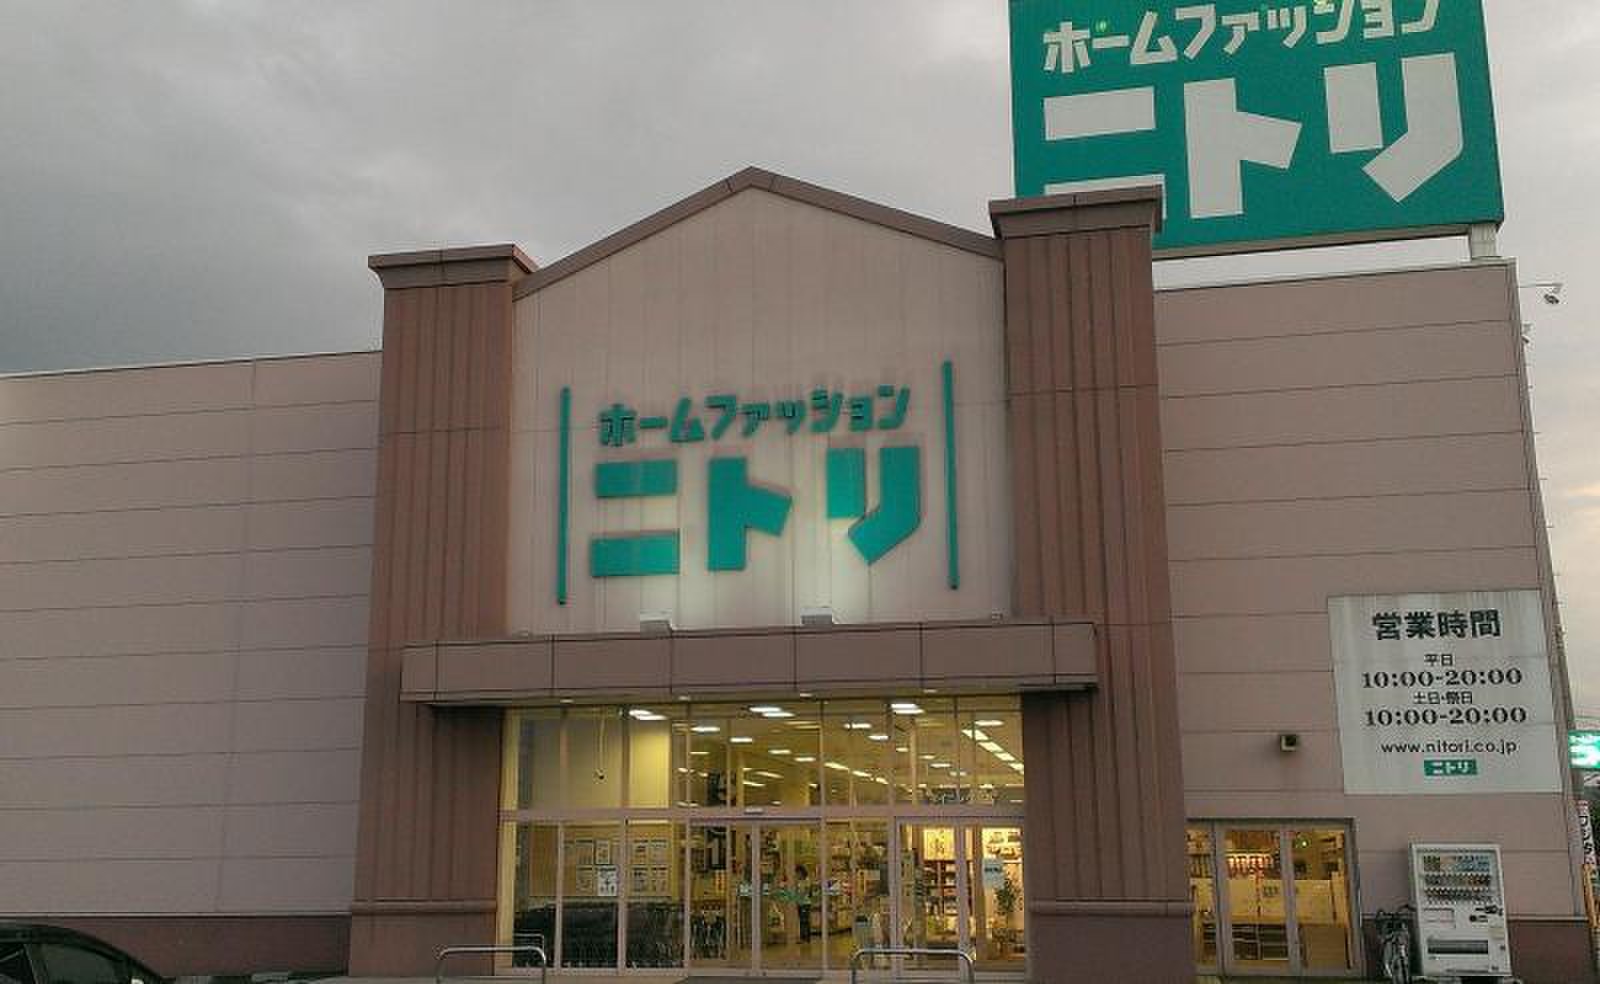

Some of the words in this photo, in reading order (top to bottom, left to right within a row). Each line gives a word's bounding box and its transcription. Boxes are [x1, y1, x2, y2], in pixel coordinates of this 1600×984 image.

[1043, 53, 1464, 219] ニトリ
[599, 384, 910, 447] ホームファッション
[591, 445, 921, 577] ニトリ
[1371, 609, 1502, 641] 営業時間
[1424, 653, 1454, 667] 平日
[1362, 668, 1523, 689] 10:00-20:00
[1365, 707, 1528, 727] 10:00-20:00
[1380, 739, 1518, 755] www.nitori.co.jp
[1431, 761, 1469, 773] ニトリ
